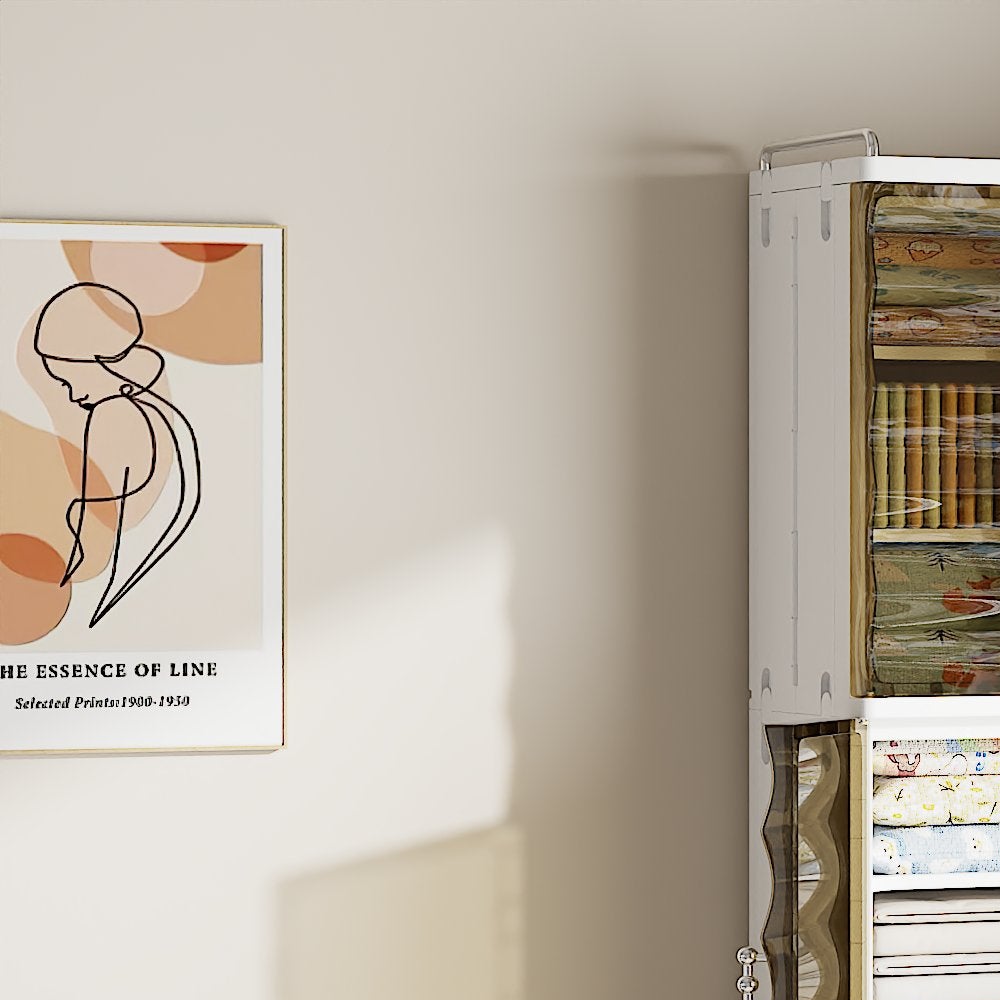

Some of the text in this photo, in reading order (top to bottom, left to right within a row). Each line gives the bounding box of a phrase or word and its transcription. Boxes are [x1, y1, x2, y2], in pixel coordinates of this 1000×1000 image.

[36, 663, 127, 679] ESSENCE
[134, 662, 162, 678] OF
[169, 662, 218, 677] LINE
[15, 696, 71, 710] Selected
